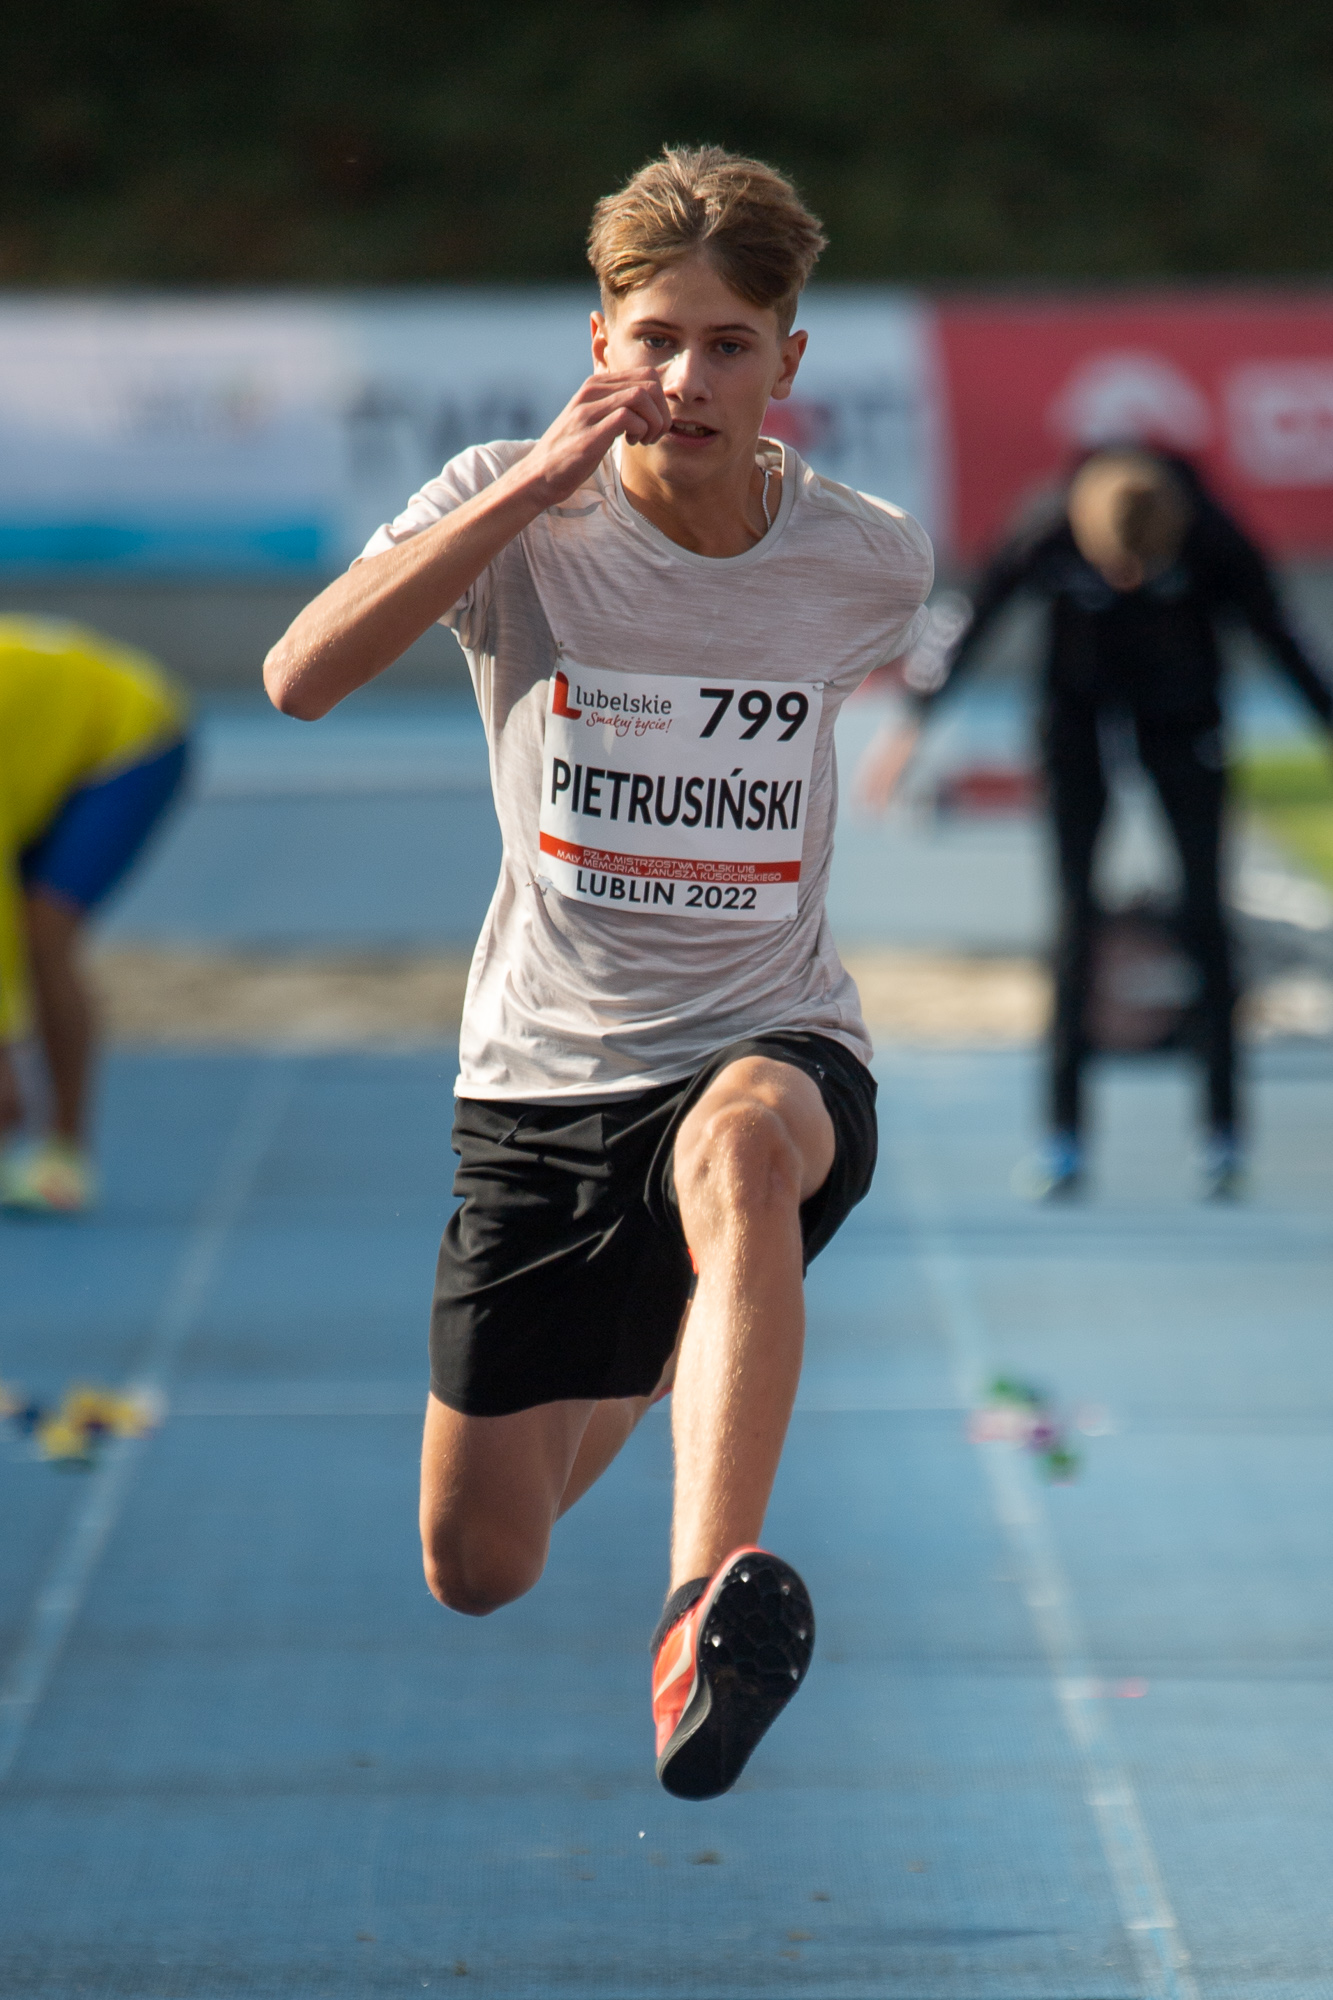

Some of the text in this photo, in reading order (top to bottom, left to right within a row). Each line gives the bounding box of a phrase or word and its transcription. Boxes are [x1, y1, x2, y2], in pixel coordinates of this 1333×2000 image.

[576, 685, 672, 715] lubelskie
[699, 687, 809, 742] 799
[586, 711, 673, 737] Smakuj życie!
[551, 757, 803, 831] PIETRUSIŃSKI
[583, 849, 755, 874] PZLA MISTRZOSTWA POLSKI U16
[644, 867, 698, 880] JANUSZA
[576, 869, 757, 910] LUBLIN 2022
